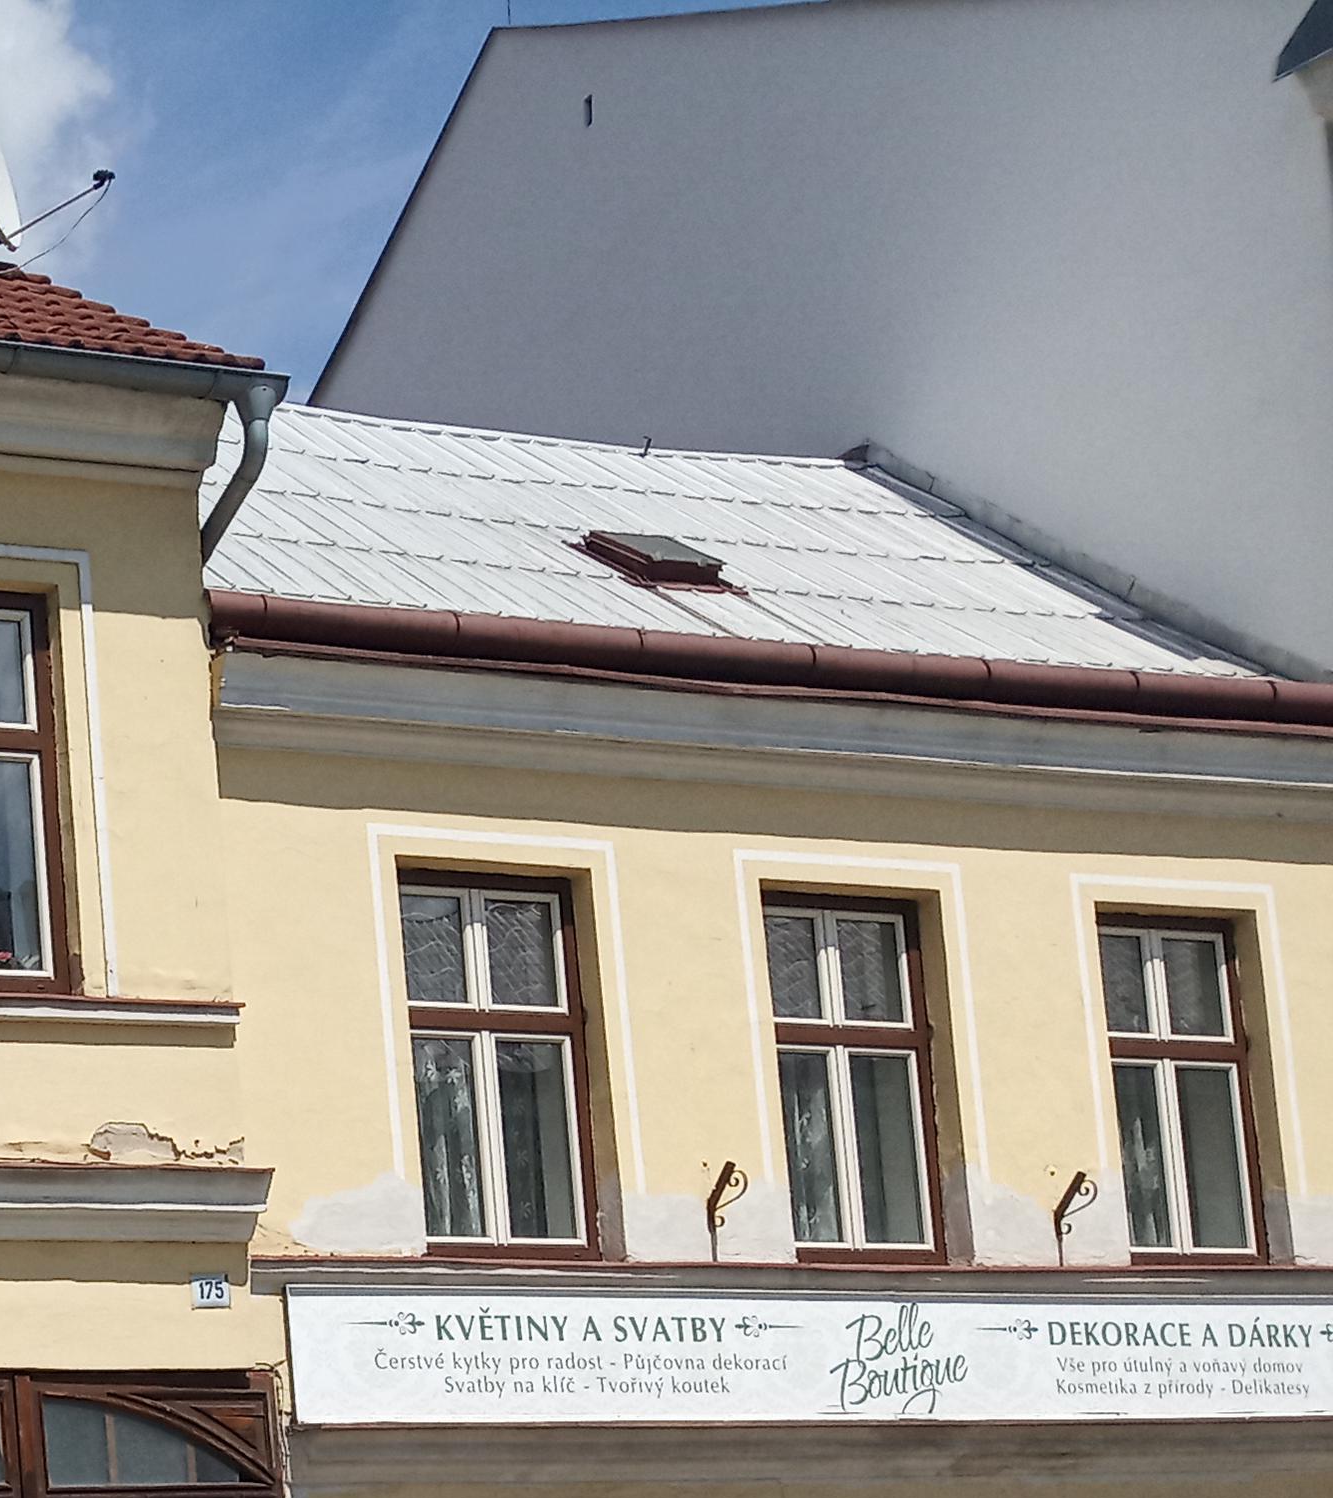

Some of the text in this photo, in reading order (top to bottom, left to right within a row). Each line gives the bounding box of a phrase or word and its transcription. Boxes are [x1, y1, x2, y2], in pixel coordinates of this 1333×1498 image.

[198, 1280, 225, 1301] 175
[435, 1306, 726, 1343] KVĚTINY A SVATBY
[845, 1302, 934, 1363] Belle
[1047, 1316, 1313, 1348] DEKORACE A DÁRKY
[374, 1348, 445, 1370] Čerstvé
[452, 1352, 502, 1375] kytky
[509, 1357, 540, 1375] pro
[547, 1352, 603, 1370] radost
[623, 1353, 706, 1375] Půjčovna
[712, 1353, 788, 1371] dekorací
[1056, 1356, 1303, 1377] Vše pro útulný a voňavý domov
[444, 1375, 506, 1399] Svatby
[513, 1381, 535, 1393] na
[542, 1375, 576, 1394] klíč
[596, 1376, 664, 1399] Tvořivý
[671, 1376, 731, 1394] koutek
[829, 1353, 969, 1414] Boutique
[1056, 1378, 1137, 1395] Kosmetika
[1144, 1383, 1152, 1394] z
[1158, 1378, 1214, 1399] přírody
[1231, 1378, 1310, 1398] Delikatesy
